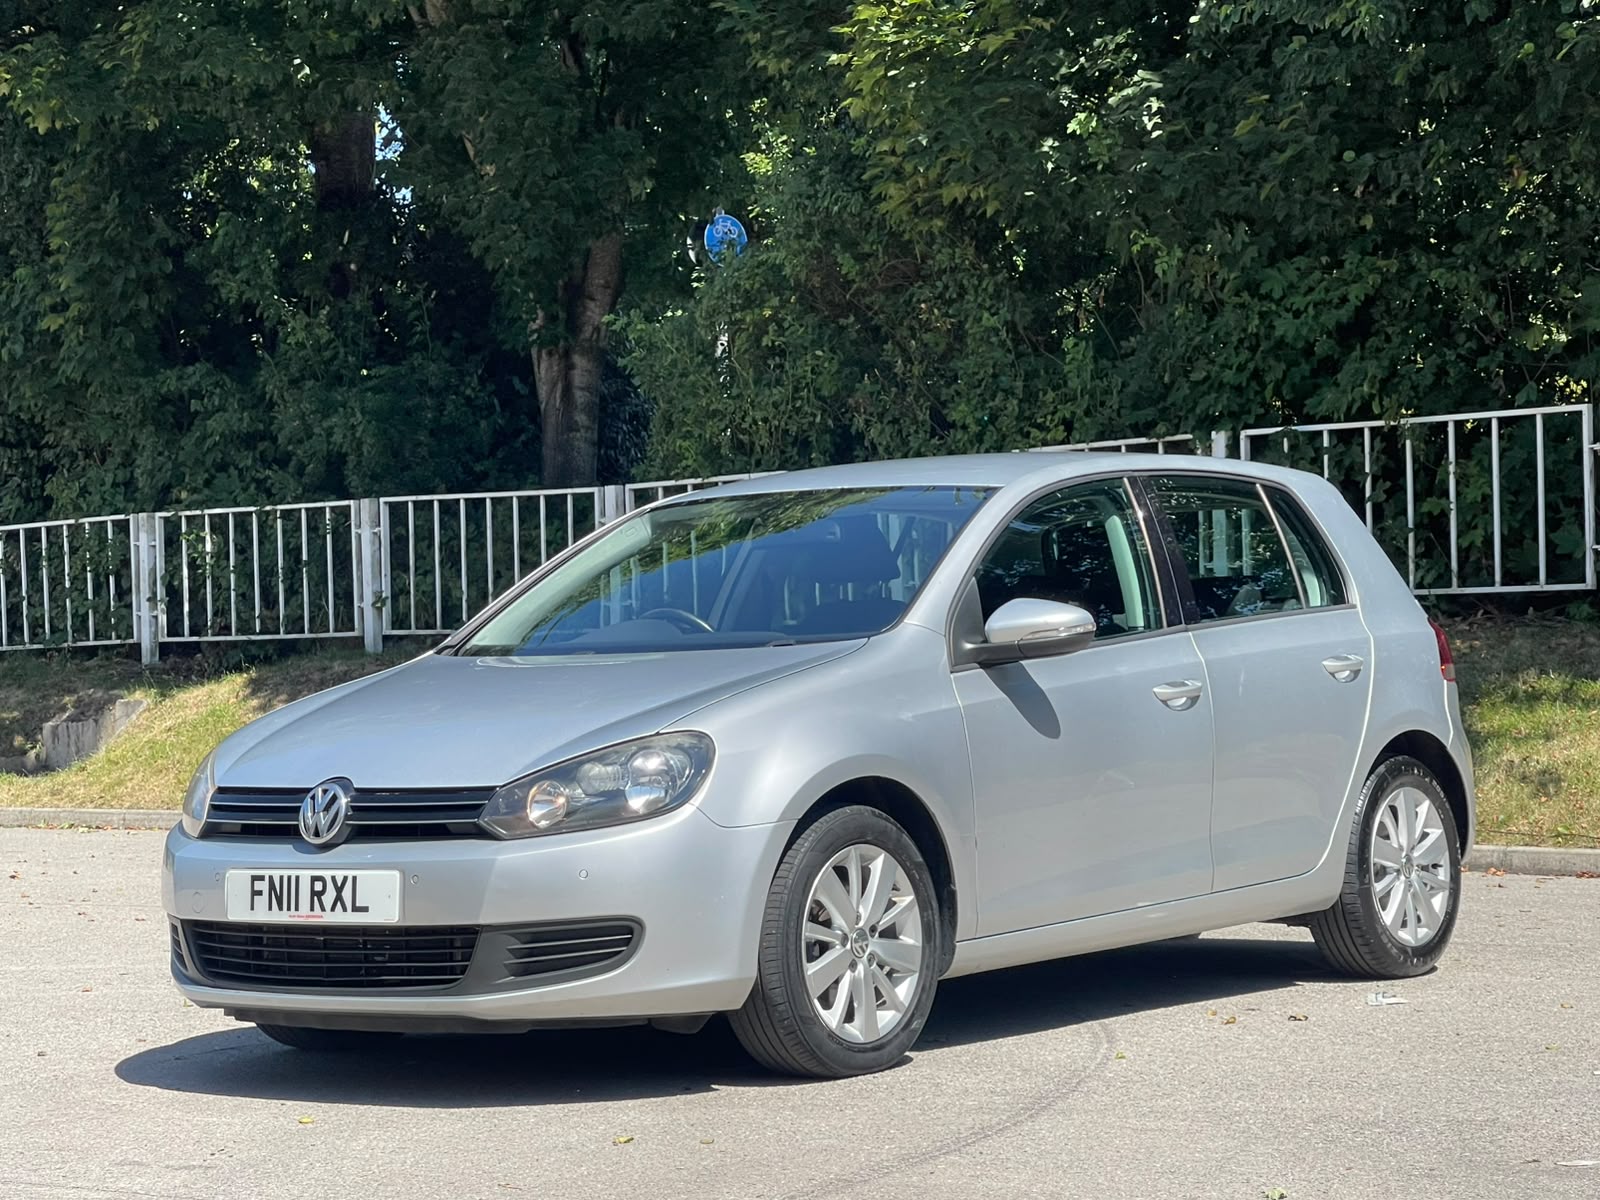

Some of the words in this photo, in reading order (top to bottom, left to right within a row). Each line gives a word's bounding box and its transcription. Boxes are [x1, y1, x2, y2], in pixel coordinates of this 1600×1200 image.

[300, 784, 345, 843] VW
[250, 875, 300, 912] FN11
[309, 875, 370, 913] RXL
